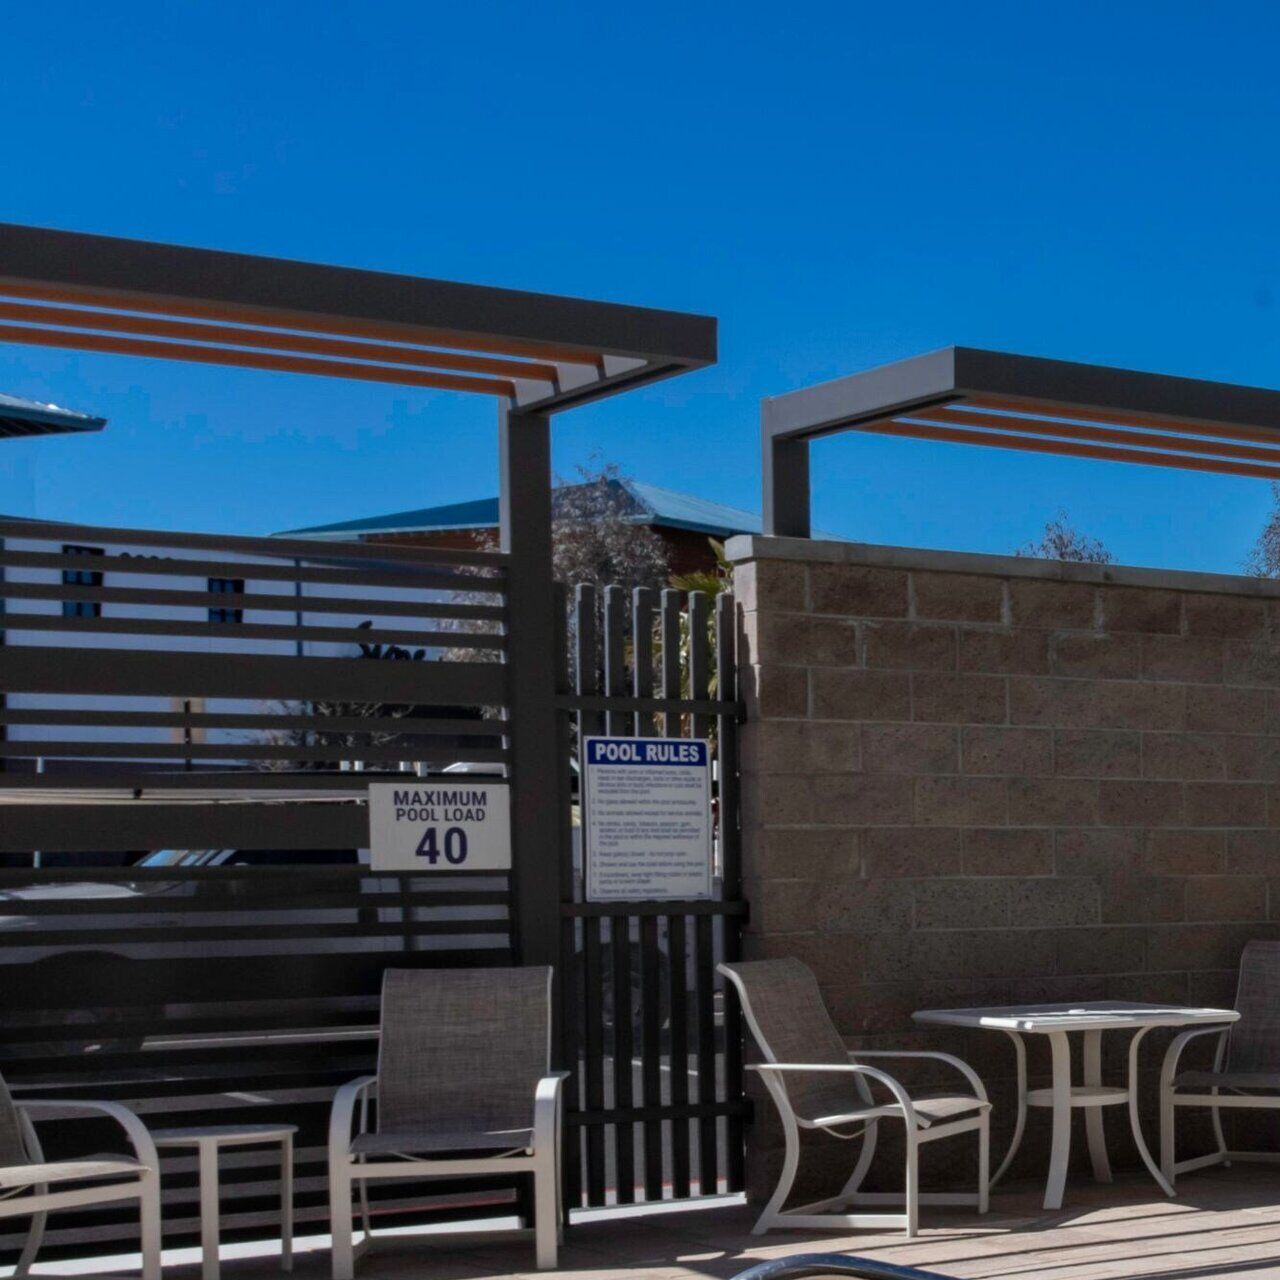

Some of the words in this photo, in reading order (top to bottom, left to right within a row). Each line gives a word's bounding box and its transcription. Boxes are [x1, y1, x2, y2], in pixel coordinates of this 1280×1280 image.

[595, 743, 642, 761] POOL
[646, 744, 700, 762] RULES
[394, 791, 487, 806] MAXIMUM
[396, 808, 439, 821] POOL
[445, 808, 486, 821] LOAD
[415, 827, 468, 865] 40
